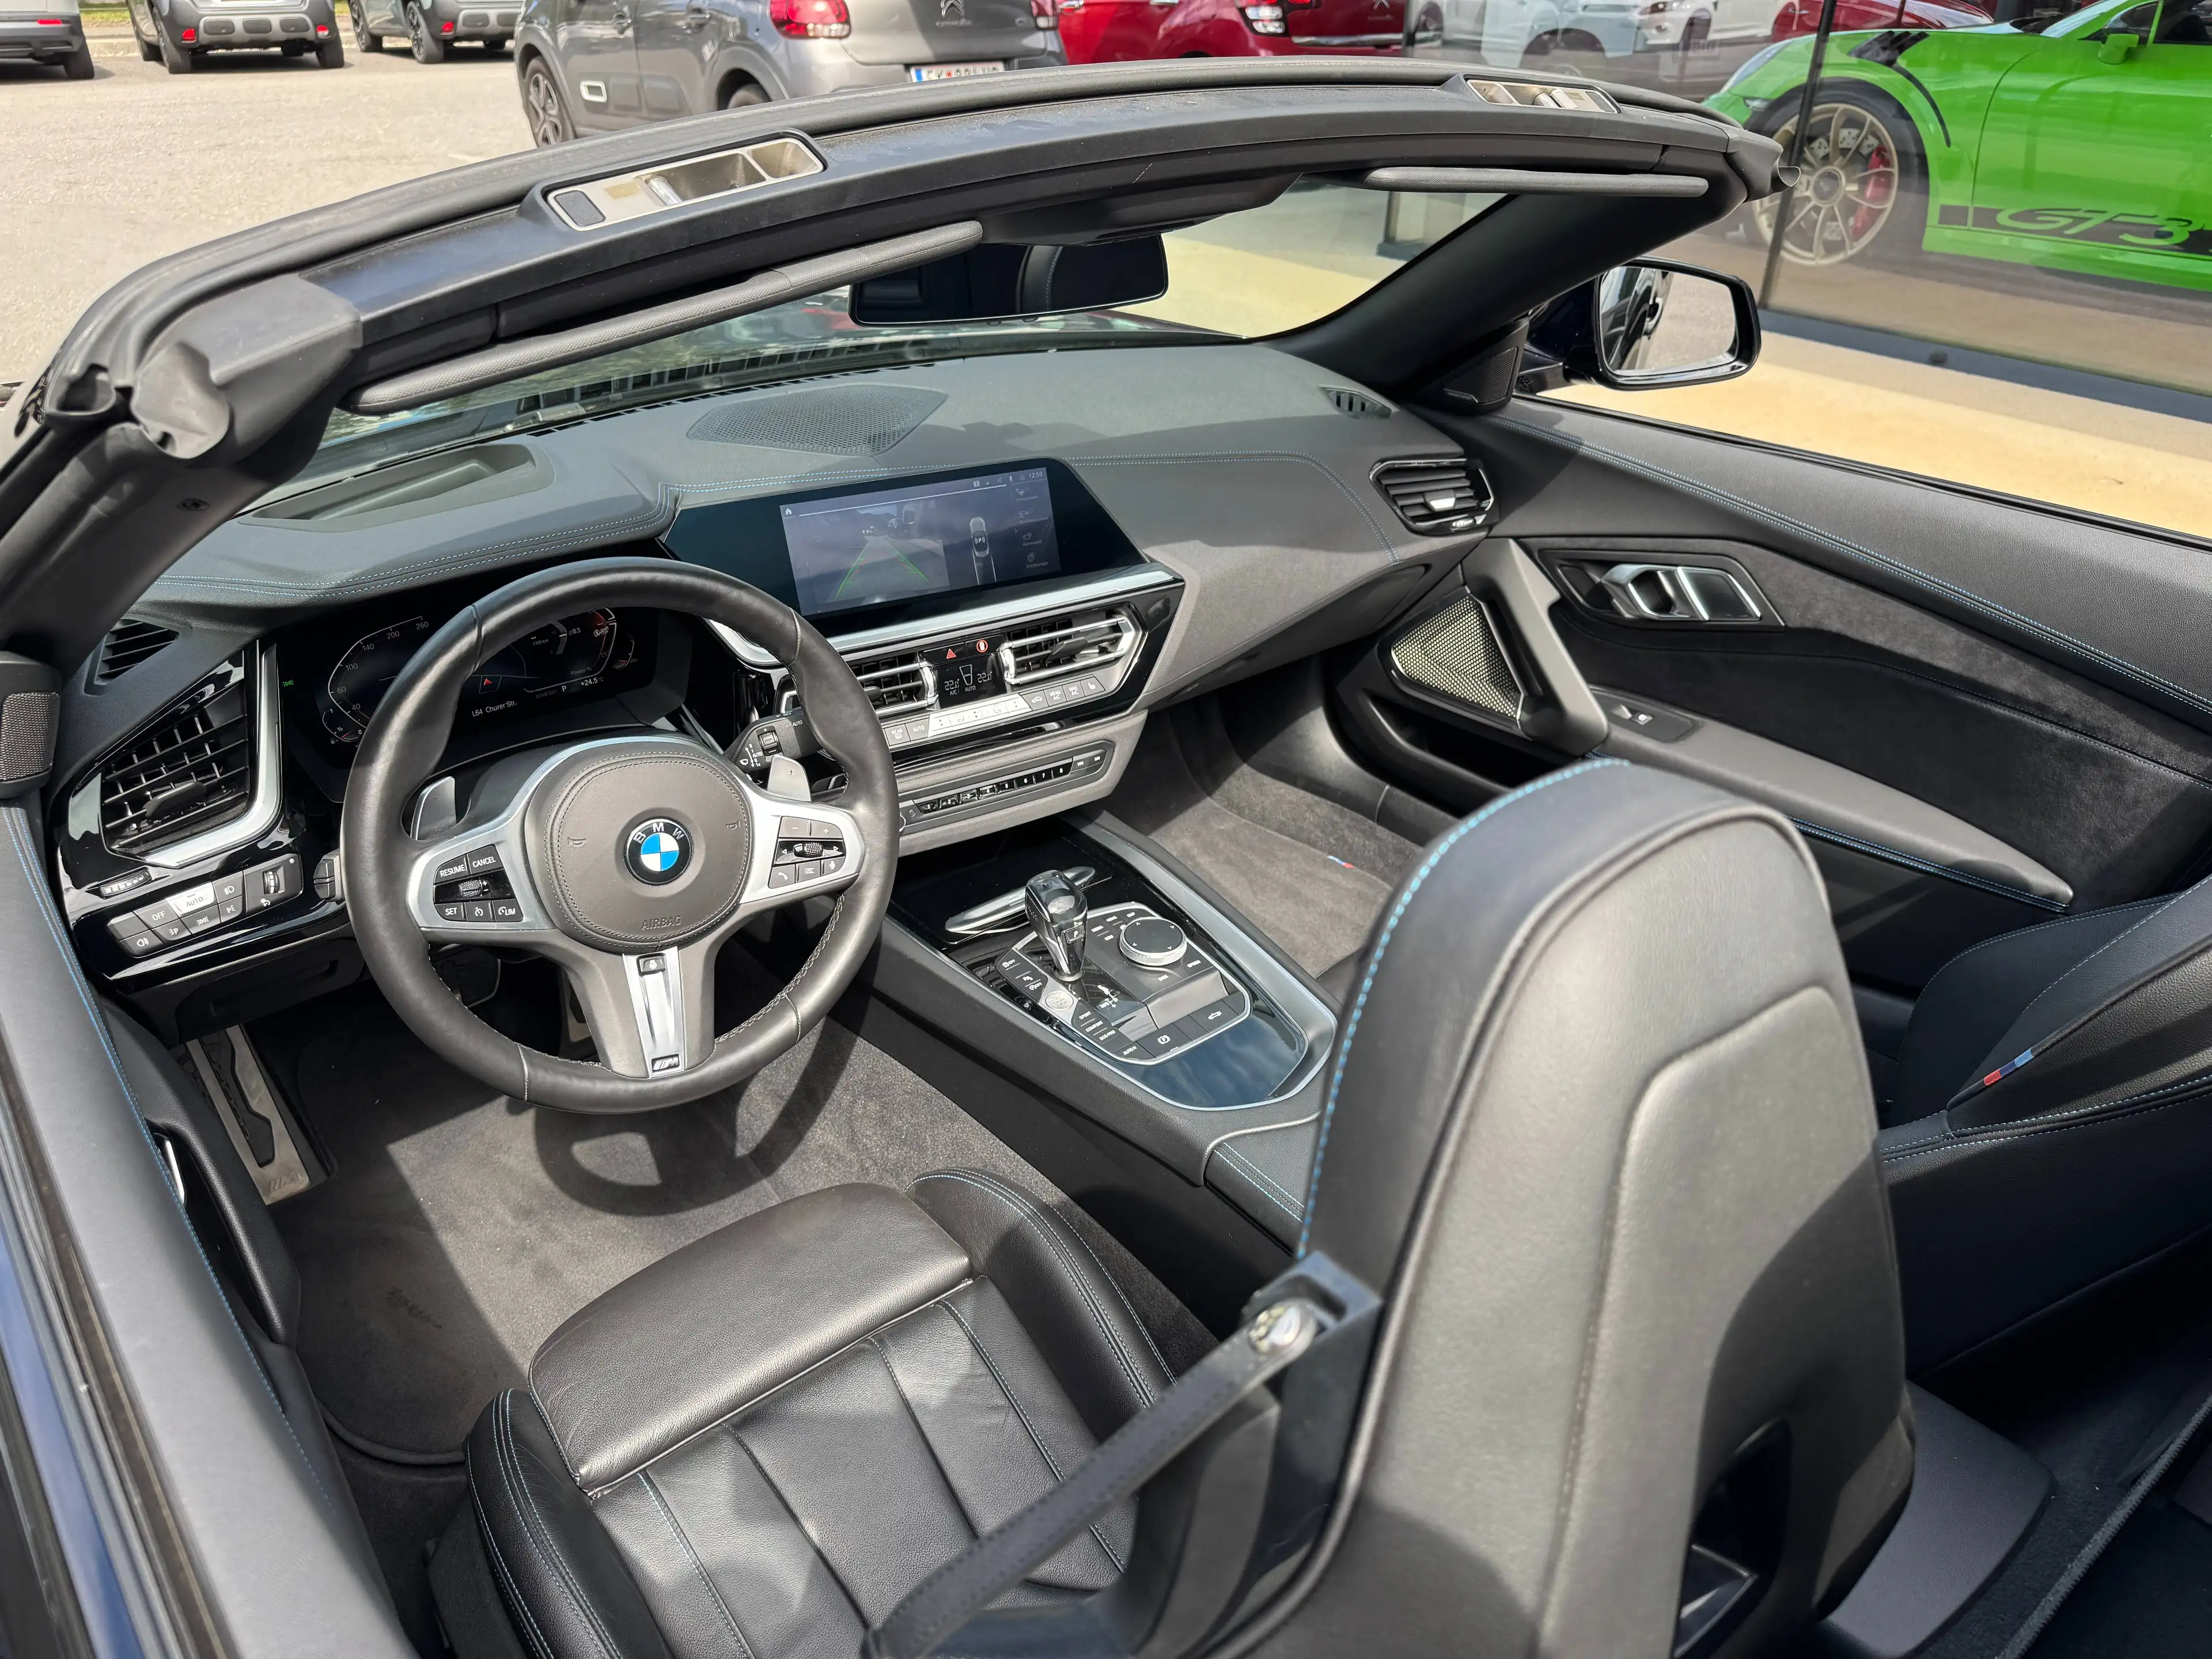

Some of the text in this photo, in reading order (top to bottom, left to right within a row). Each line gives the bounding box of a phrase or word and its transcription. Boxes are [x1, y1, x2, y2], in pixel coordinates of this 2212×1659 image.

[1995, 209, 2194, 245] GT3
[415, 621, 429, 630] 260
[386, 630, 400, 639] 200
[362, 643, 375, 652] 140
[346, 662, 358, 671] 100
[351, 703, 361, 711] 40
[472, 700, 517, 717] L64 Churer Str.
[634, 823, 684, 844] BMW
[472, 856, 496, 868] CANCEL
[440, 864, 466, 877] RESUME
[186, 897, 204, 908] AUTO
[152, 911, 166, 921] OFF
[445, 907, 457, 915] SET
[505, 908, 516, 916] LIM
[641, 915, 681, 930] AIRBAG
[1079, 1011, 1092, 1020] SPORT
[1085, 1020, 1104, 1032] COMFORT
[1099, 1033, 1108, 1041] ECO
[1123, 1046, 1132, 1056] AUTO
